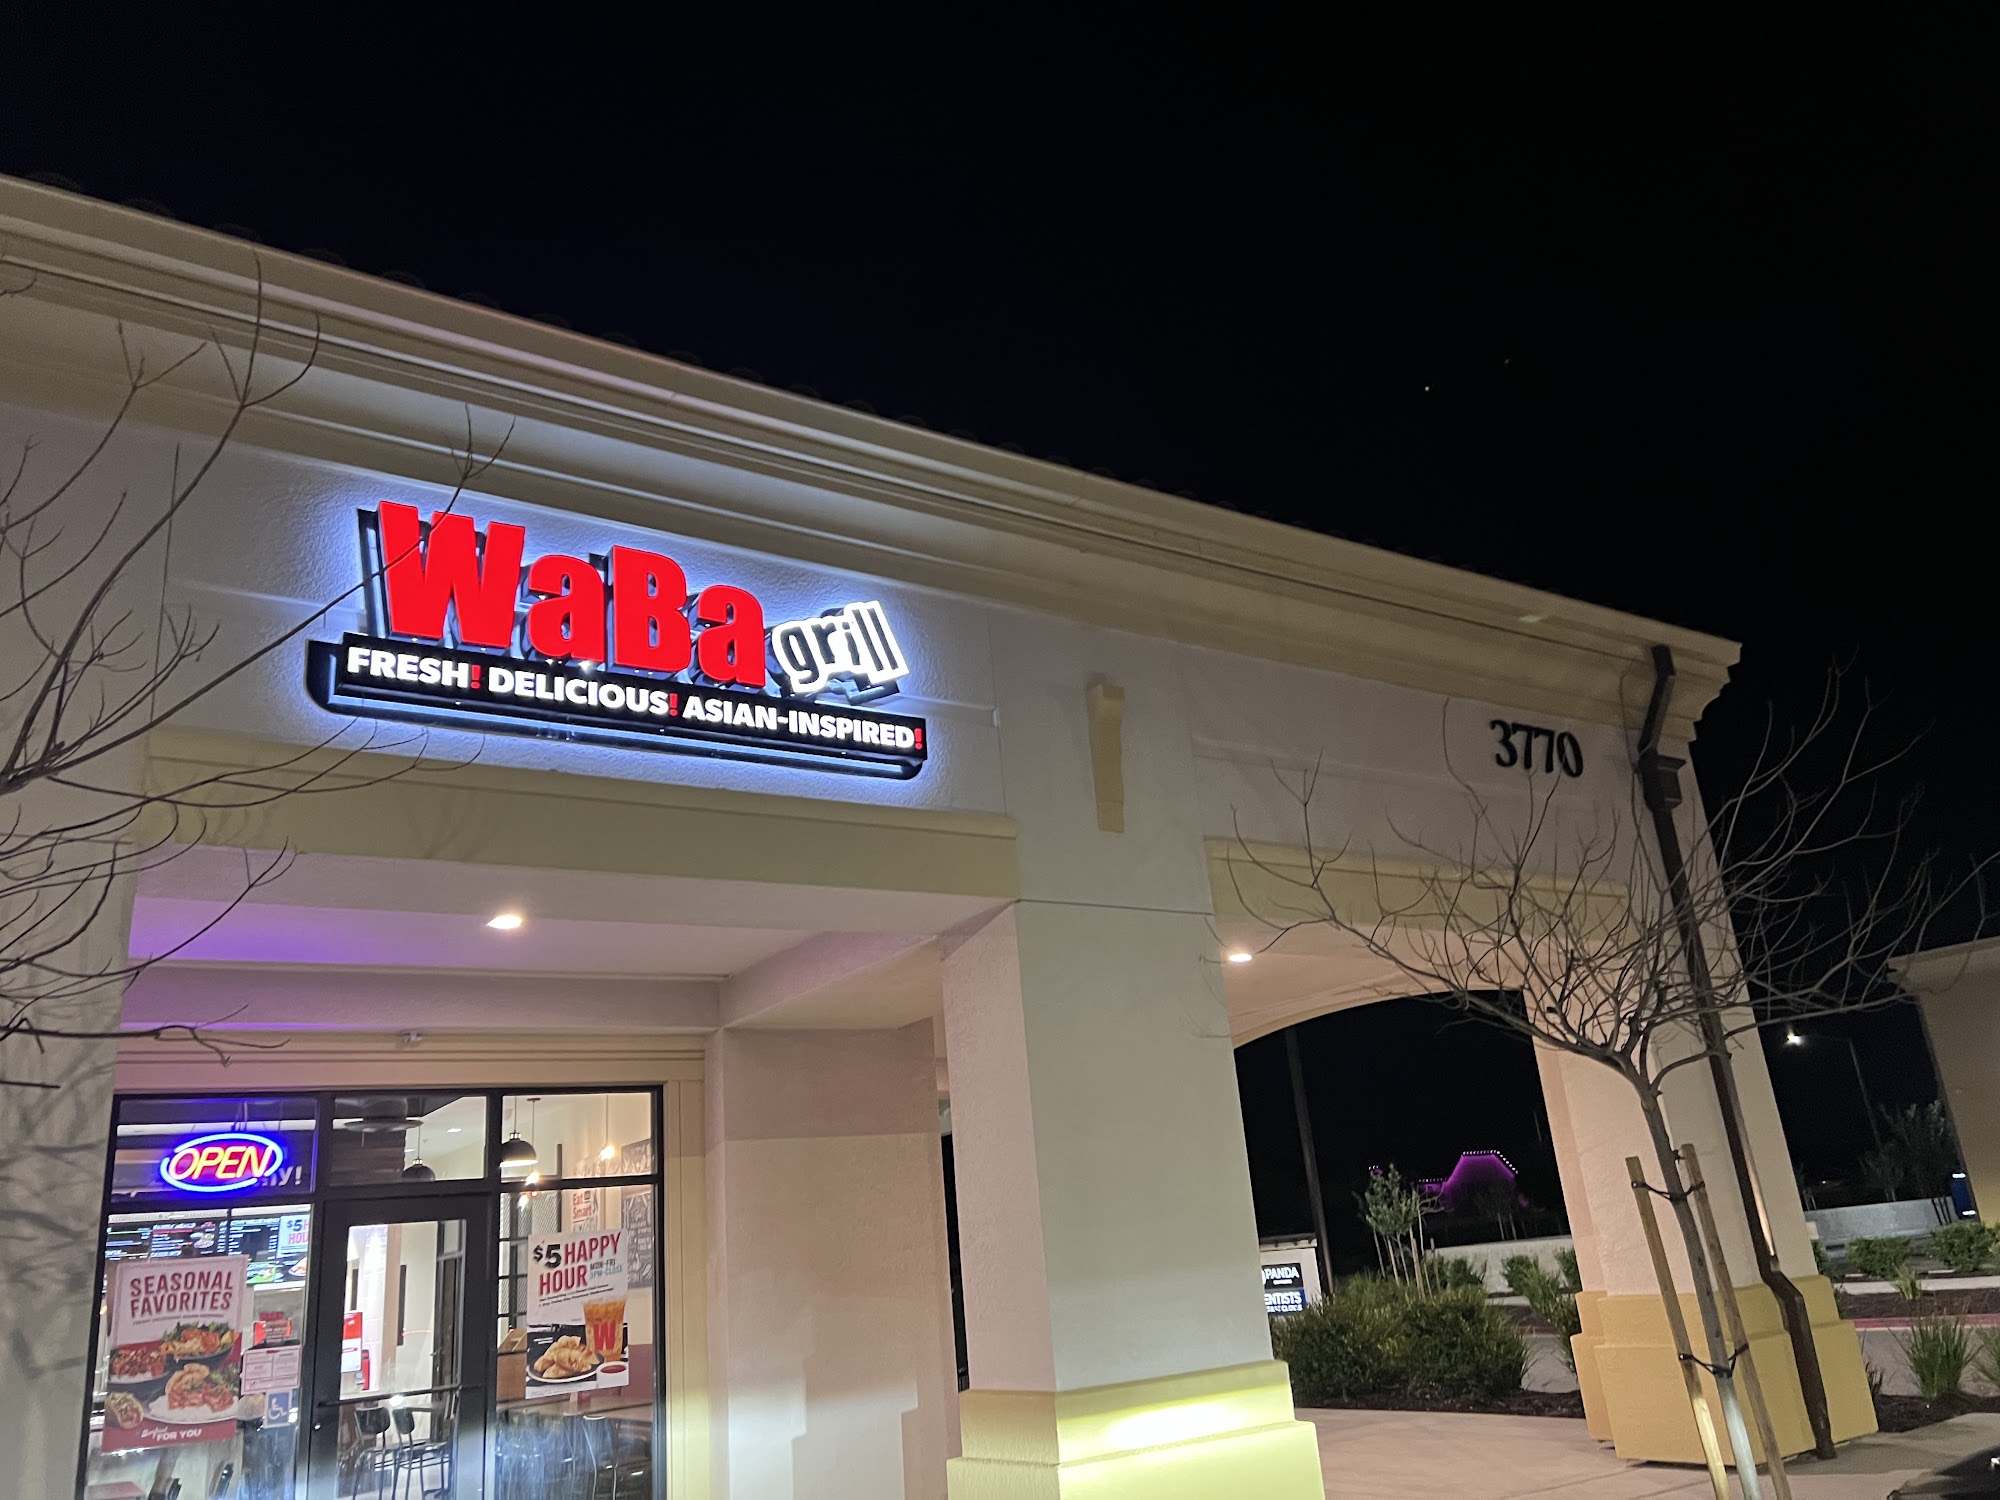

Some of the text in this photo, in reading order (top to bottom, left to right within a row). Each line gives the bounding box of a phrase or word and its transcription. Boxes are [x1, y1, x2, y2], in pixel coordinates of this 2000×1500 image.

[376, 500, 910, 693] WaBa grill
[346, 646, 924, 750] FRESH! DELICIOUS! ASIAN-INSPIRED!
[1489, 719, 1584, 777] 3770
[168, 1146, 274, 1181] OPEN
[286, 1219, 303, 1232] $5
[288, 1232, 309, 1245] HOU
[533, 1243, 562, 1269] $5
[563, 1231, 622, 1266] HAPPY
[130, 1271, 233, 1298] SEASONAL
[538, 1265, 588, 1297] HOUR
[1264, 1267, 1300, 1279] PANDA
[130, 1292, 233, 1318] FAVORITES
[1264, 1291, 1302, 1305] ENTISTS
[592, 1319, 618, 1352] W
[156, 1431, 178, 1442] FOR
[179, 1428, 202, 1440] YOU
